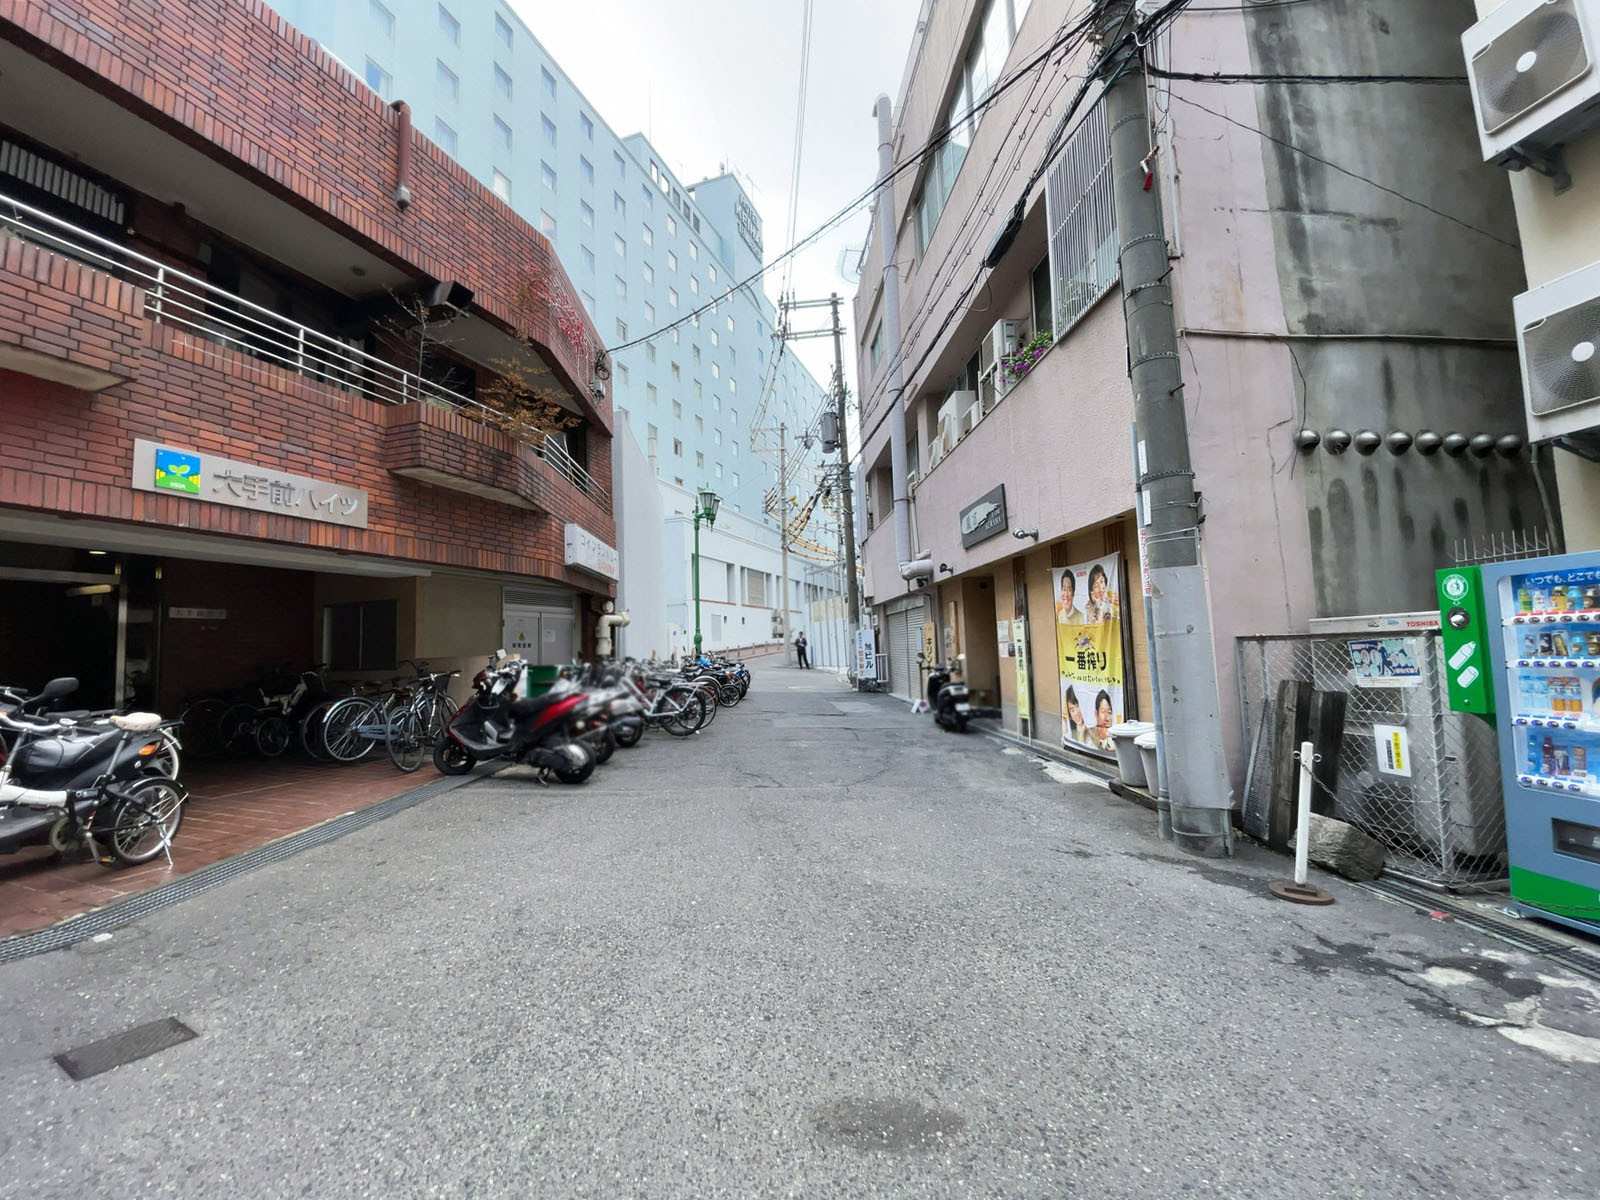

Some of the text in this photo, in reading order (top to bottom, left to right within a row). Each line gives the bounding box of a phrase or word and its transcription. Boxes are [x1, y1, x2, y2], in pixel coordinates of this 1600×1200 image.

[212, 469, 359, 517] 大手前ハイツ
[1407, 620, 1440, 628] TOSHIBA
[1065, 651, 1107, 671] 一番搾り
